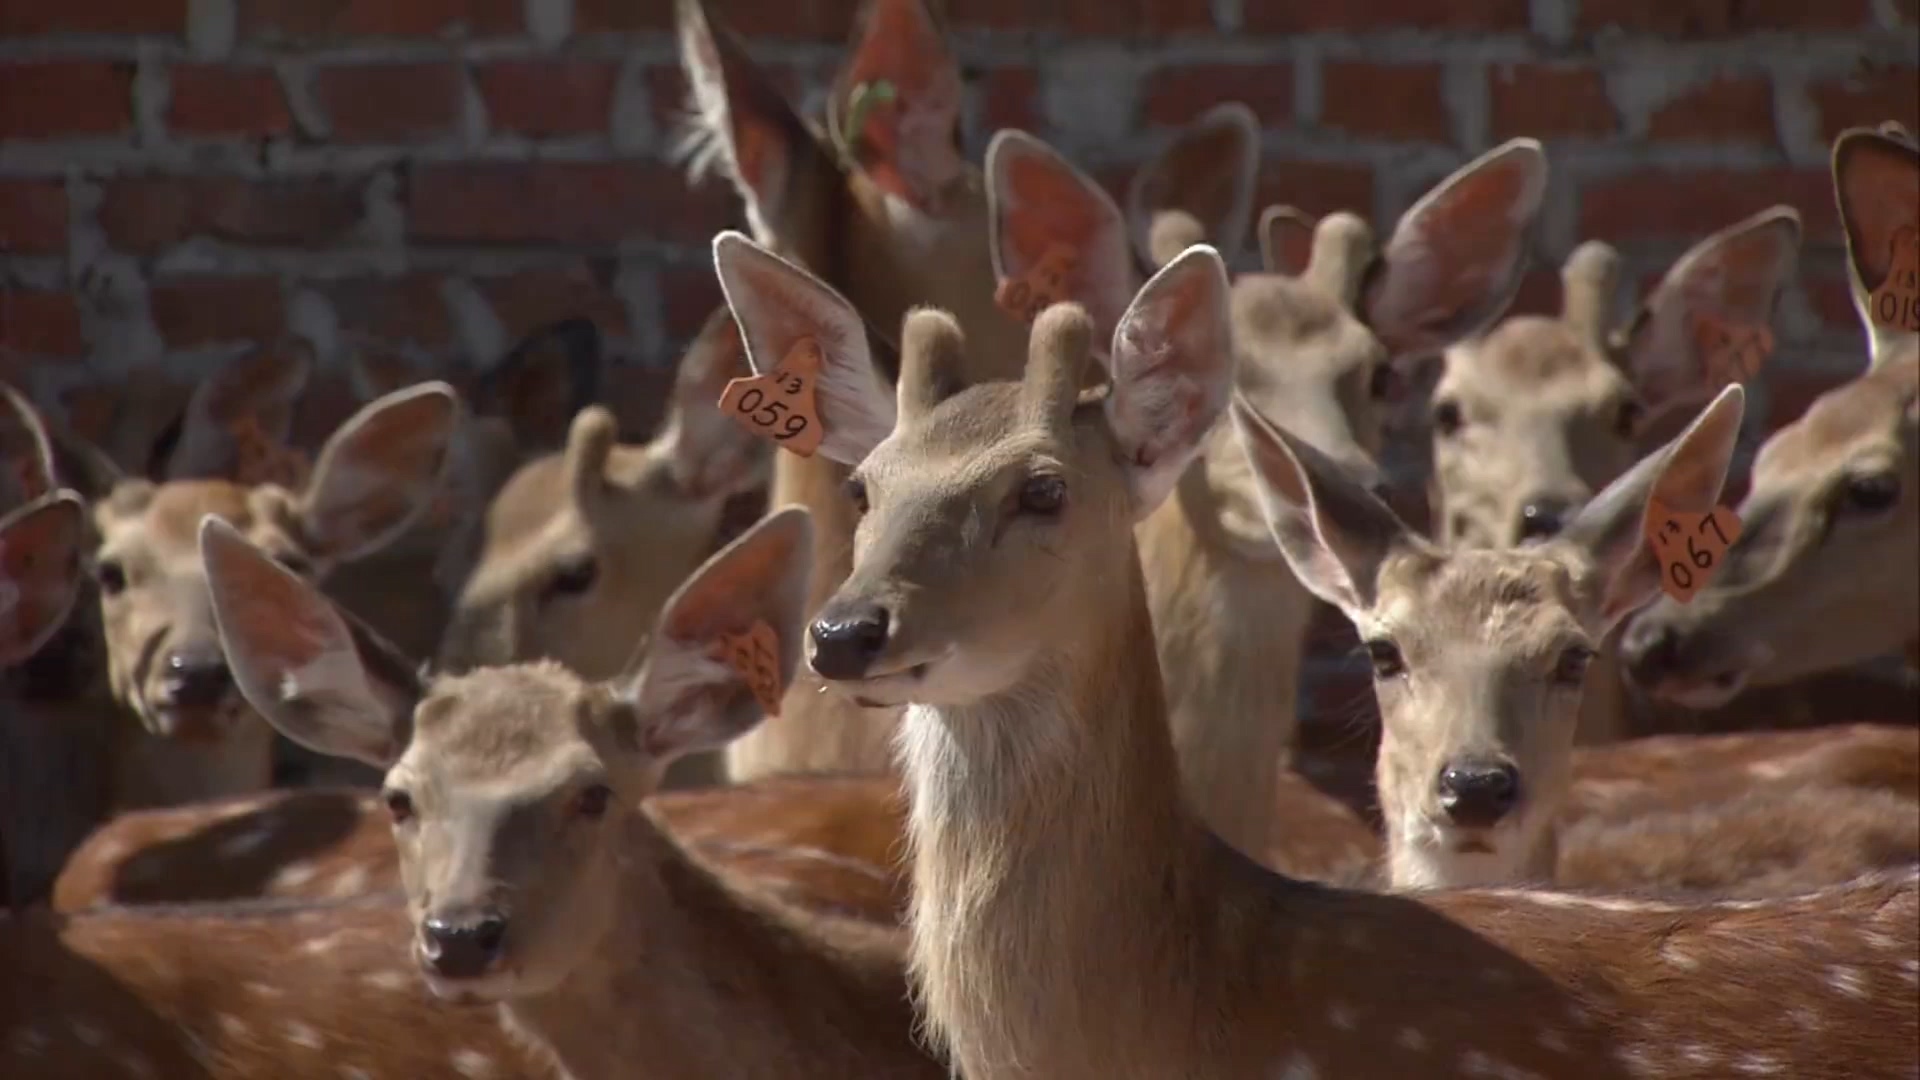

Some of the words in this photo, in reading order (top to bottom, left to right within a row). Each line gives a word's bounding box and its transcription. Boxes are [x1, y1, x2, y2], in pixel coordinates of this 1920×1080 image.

[775, 371, 803, 395] 13
[737, 388, 809, 440] 059
[1670, 512, 1729, 589] 067
